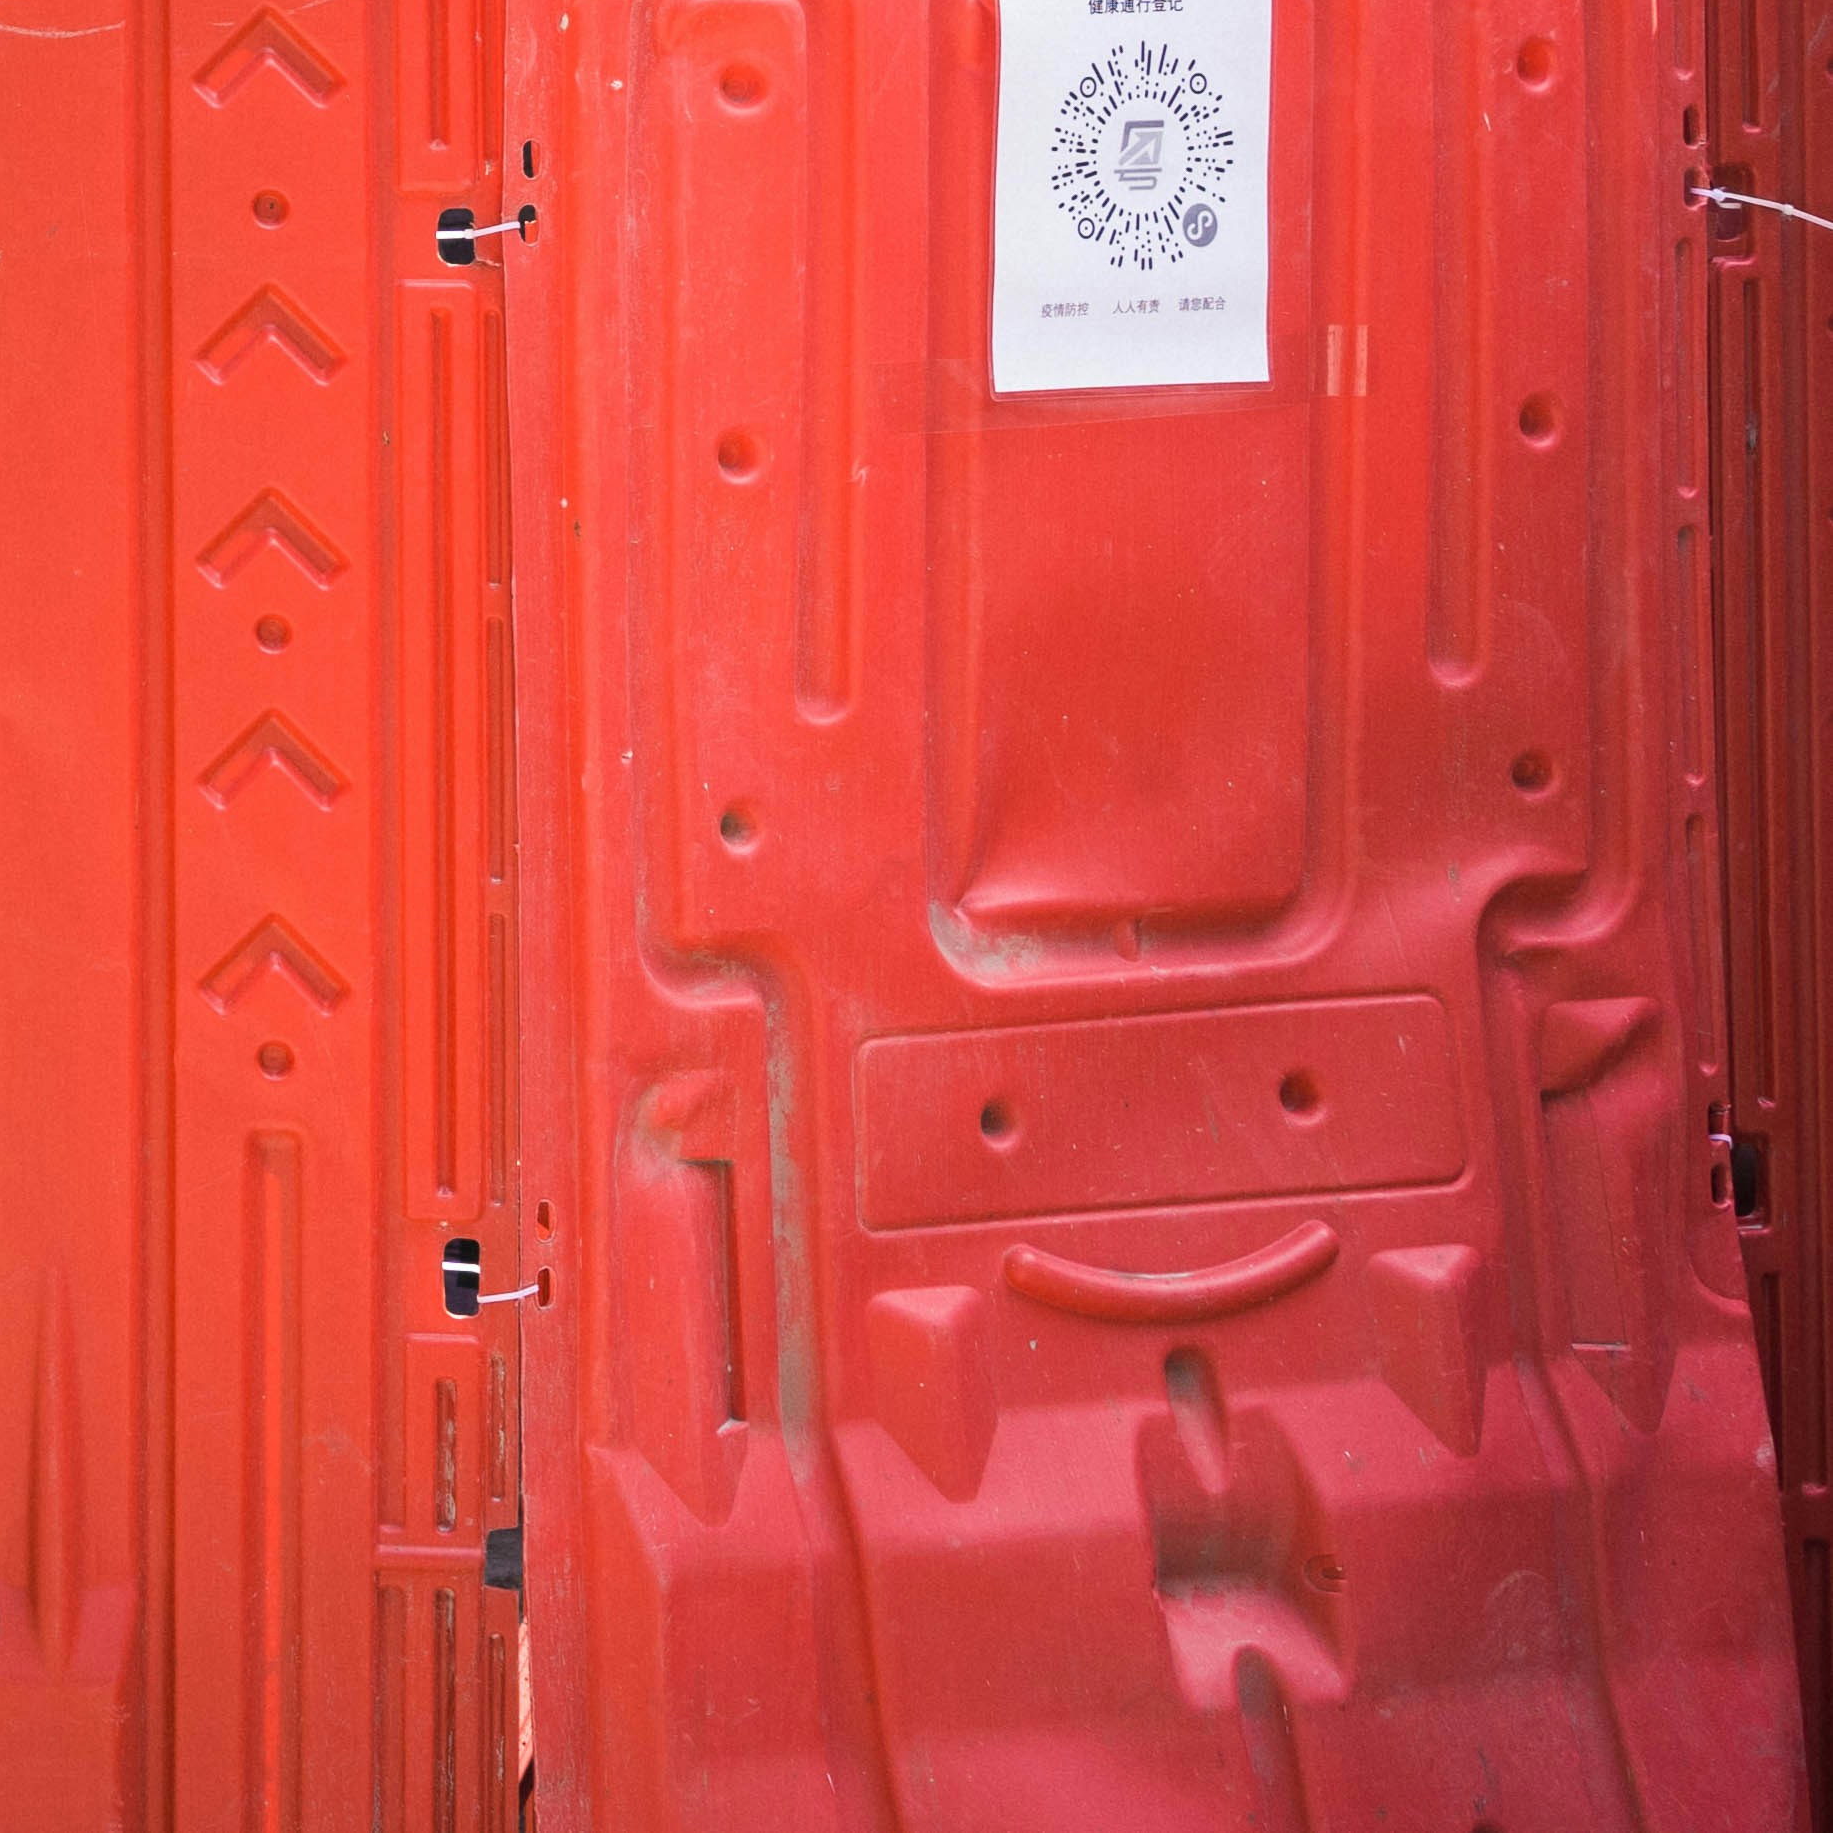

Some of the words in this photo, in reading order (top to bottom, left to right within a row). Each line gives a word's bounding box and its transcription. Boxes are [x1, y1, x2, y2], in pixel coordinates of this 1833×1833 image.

[1041, 302, 1090, 319] 疫情防控
[1112, 298, 1161, 315] 人人有责
[1178, 295, 1227, 312] 请您配合
